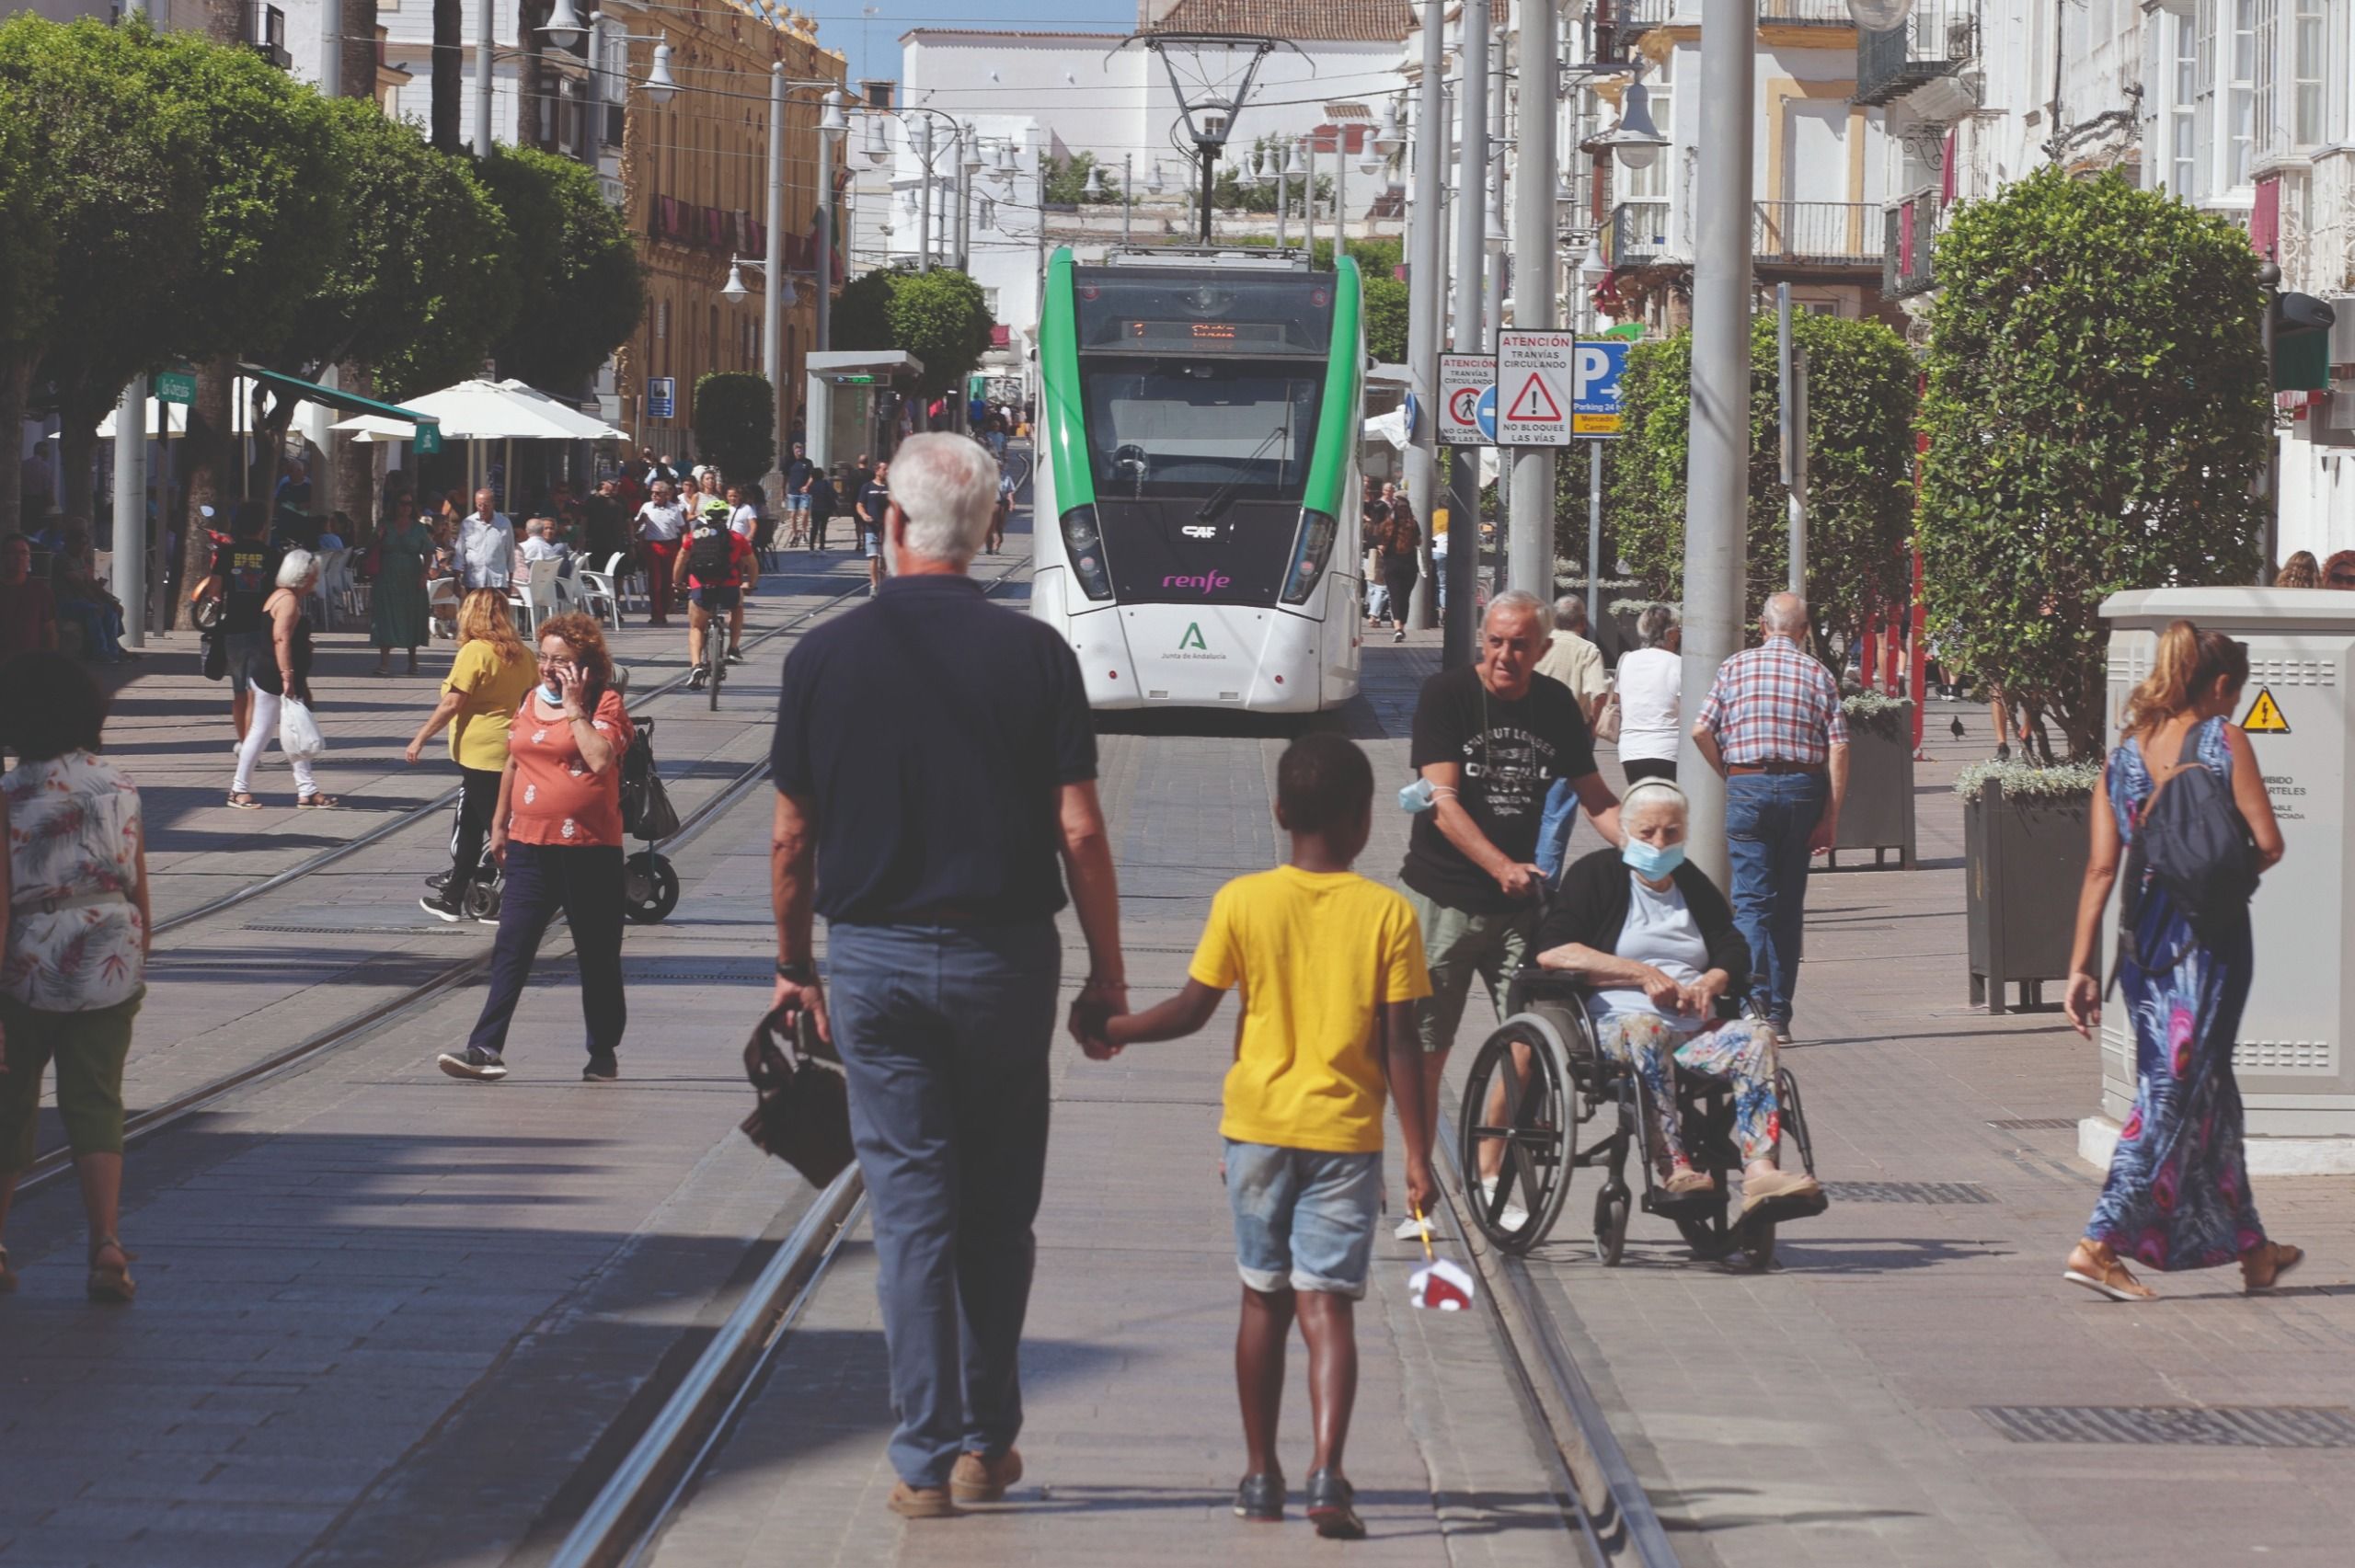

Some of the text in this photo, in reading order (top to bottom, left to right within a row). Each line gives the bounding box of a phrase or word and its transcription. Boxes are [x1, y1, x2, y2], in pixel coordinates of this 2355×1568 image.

[1502, 335, 1569, 347] ATENCIÓN
[1511, 349, 1559, 359] TRANVÍAS
[1443, 359, 1497, 368] ATENCIÓN
[1504, 361, 1567, 369] CIRCULANDO
[1574, 348, 1610, 399] P
[1574, 403, 1604, 412] Parking
[1604, 403, 1615, 411] 24
[1521, 424, 1566, 432] BLOQUEE
[1511, 432, 1557, 442] LAS VÍAS
[1181, 525, 1216, 538] CAF
[1162, 569, 1231, 594] renfe
[2268, 786, 2306, 795] RTELES
